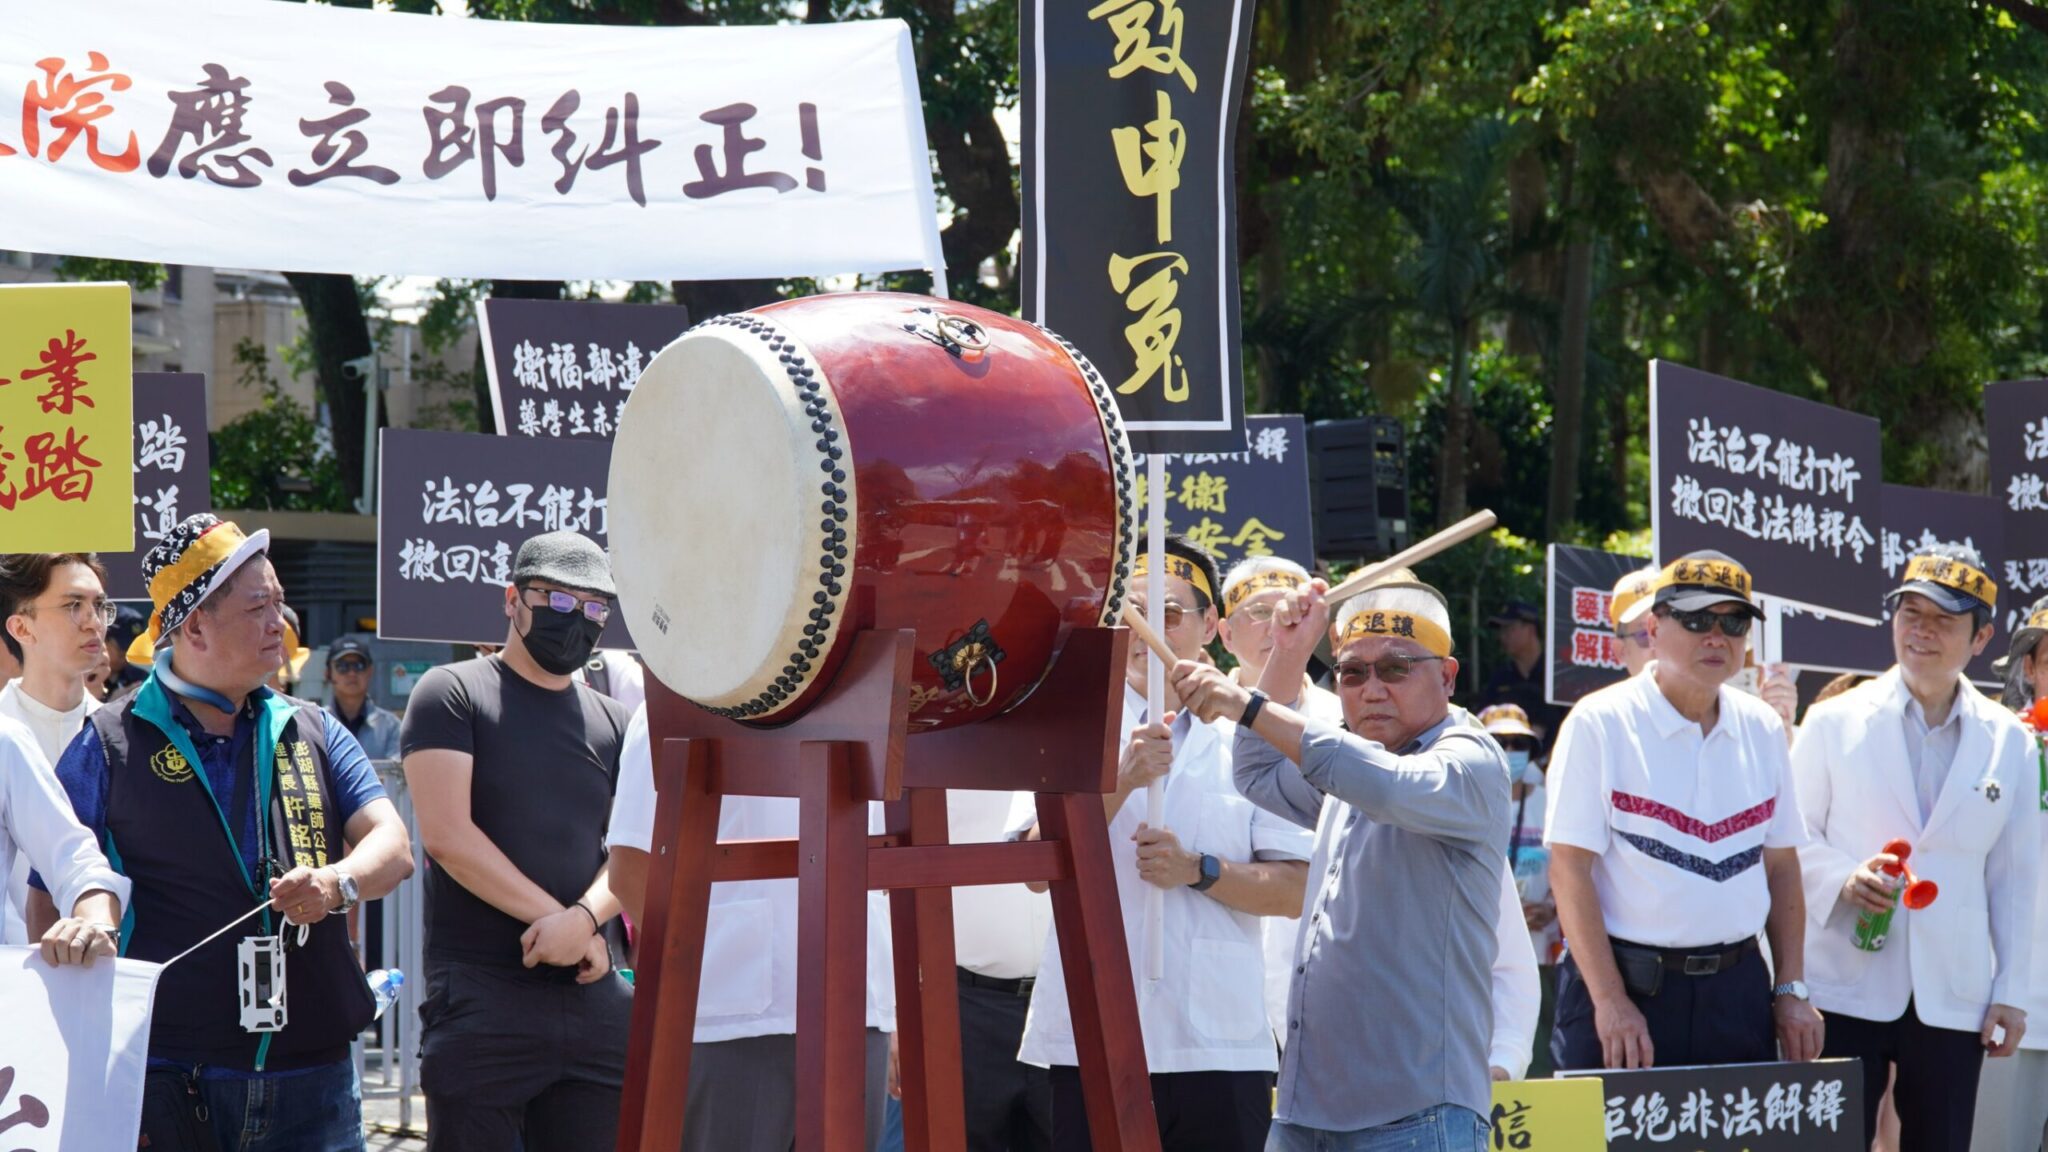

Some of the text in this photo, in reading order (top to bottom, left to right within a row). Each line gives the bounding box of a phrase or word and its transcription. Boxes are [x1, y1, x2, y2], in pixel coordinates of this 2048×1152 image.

[0, 50, 827, 208] 院應立即糾正!
[0, 329, 97, 414] 業
[513, 339, 662, 392] 衛福部違
[133, 414, 187, 473] 踏
[1688, 416, 1861, 503] 法治不能打折
[133, 484, 180, 540] 道
[1140, 517, 1285, 559] 安全
[1671, 474, 1875, 564] 撤回違法解釋令
[1492, 1100, 1532, 1151] 信
